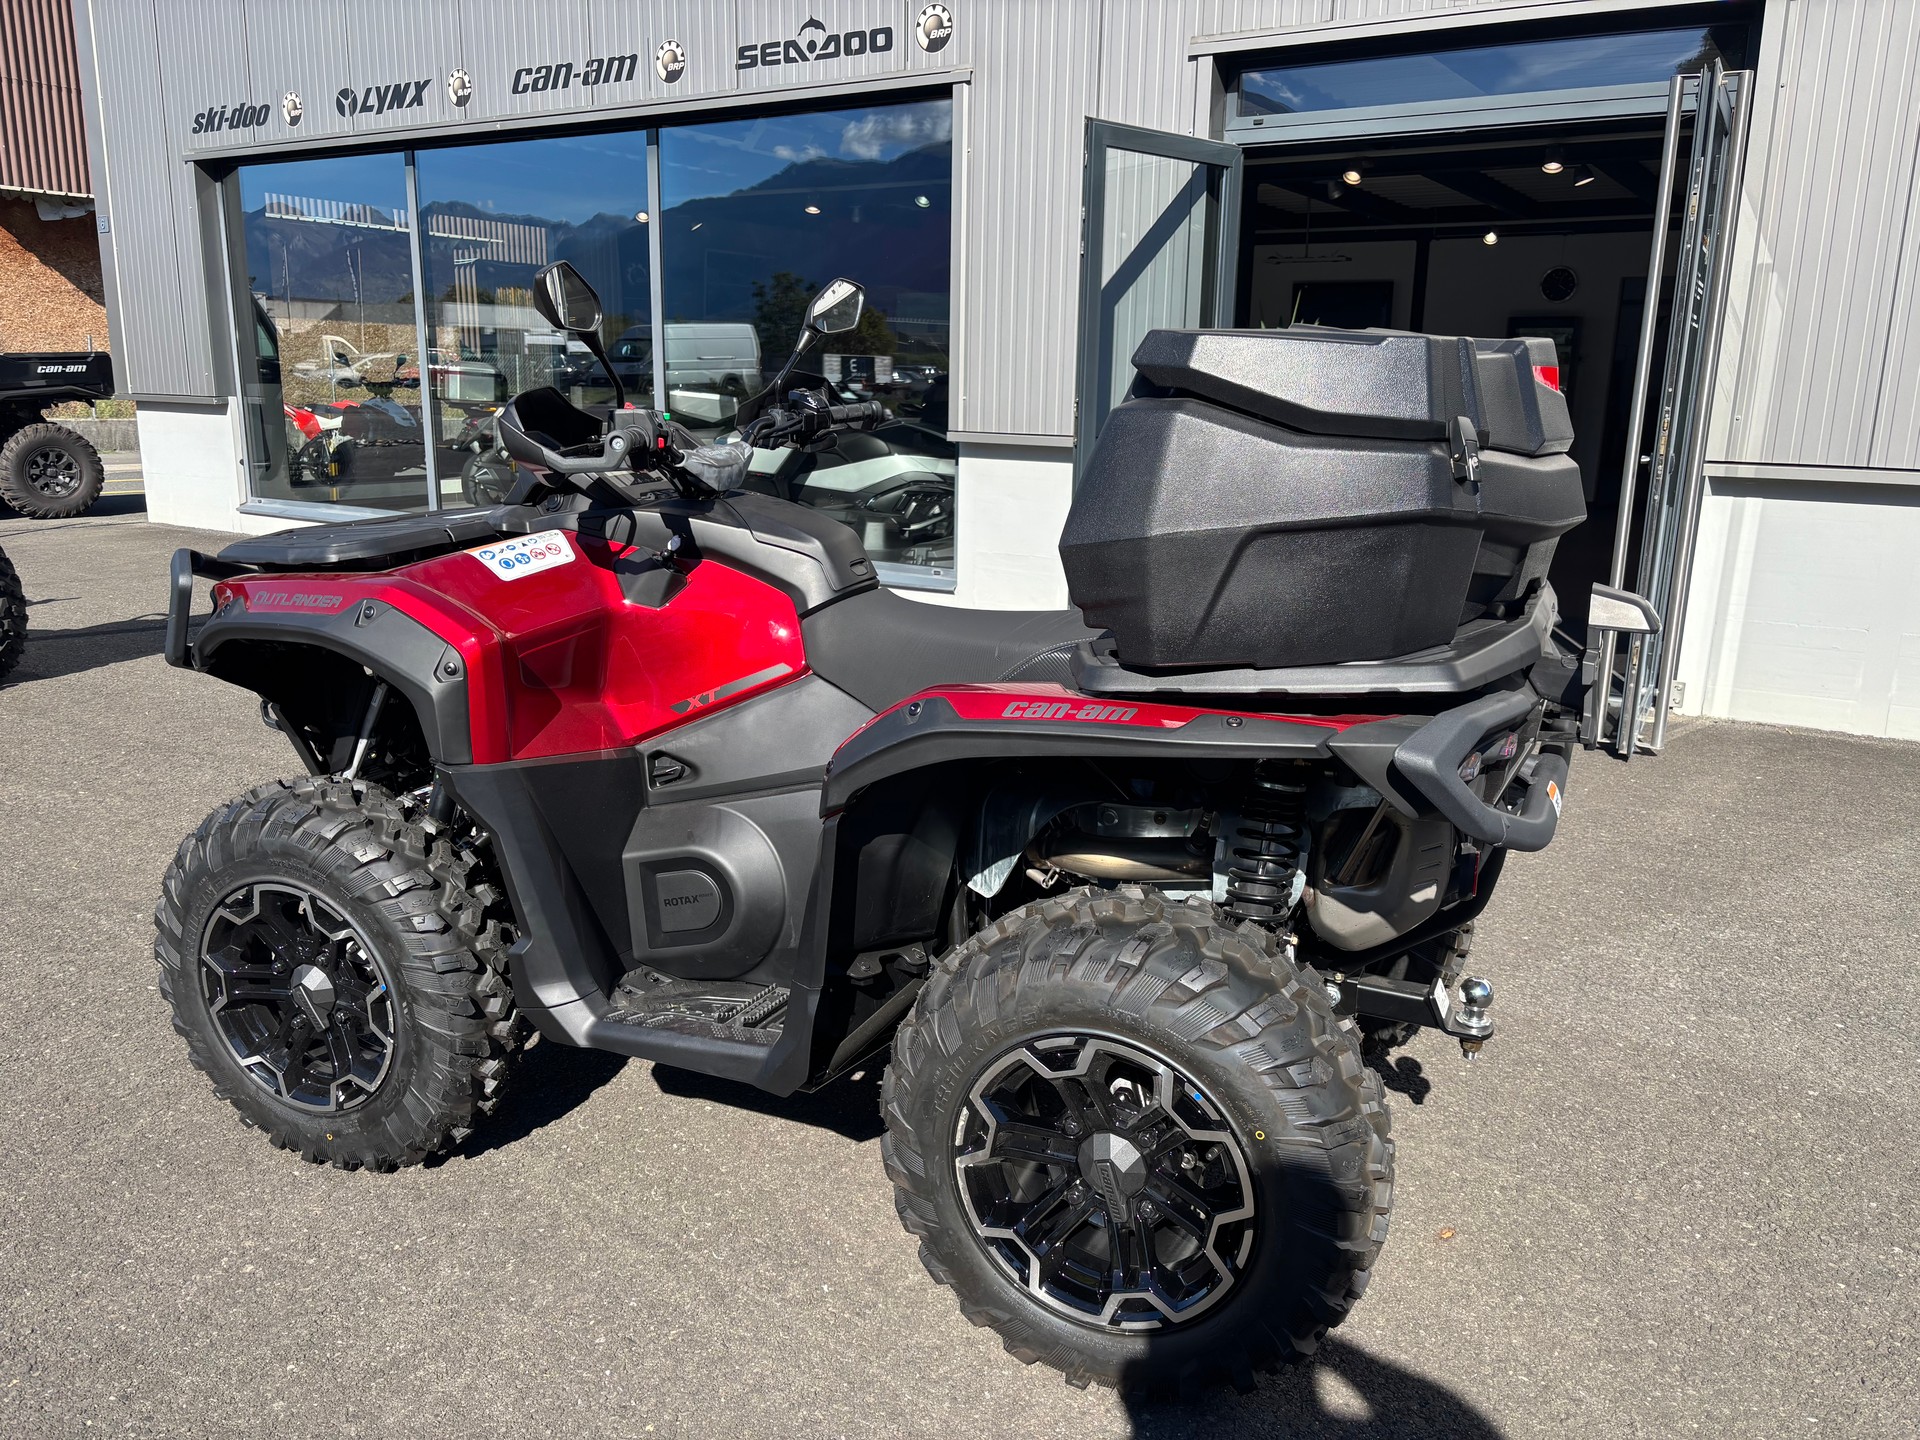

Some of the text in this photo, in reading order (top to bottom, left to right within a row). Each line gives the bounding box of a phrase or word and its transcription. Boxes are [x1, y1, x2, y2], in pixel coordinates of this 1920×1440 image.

[930, 28, 952, 39] BRP
[511, 52, 639, 95] can-am
[667, 61, 685, 71] BRP
[358, 79, 432, 115] LYNX
[192, 102, 271, 134] ski-doo
[37, 364, 87, 374] can-am
[253, 590, 343, 608] OUTLANDER
[686, 686, 721, 712] XT
[1001, 701, 1138, 721] can-am
[663, 894, 699, 908] ROTAX
